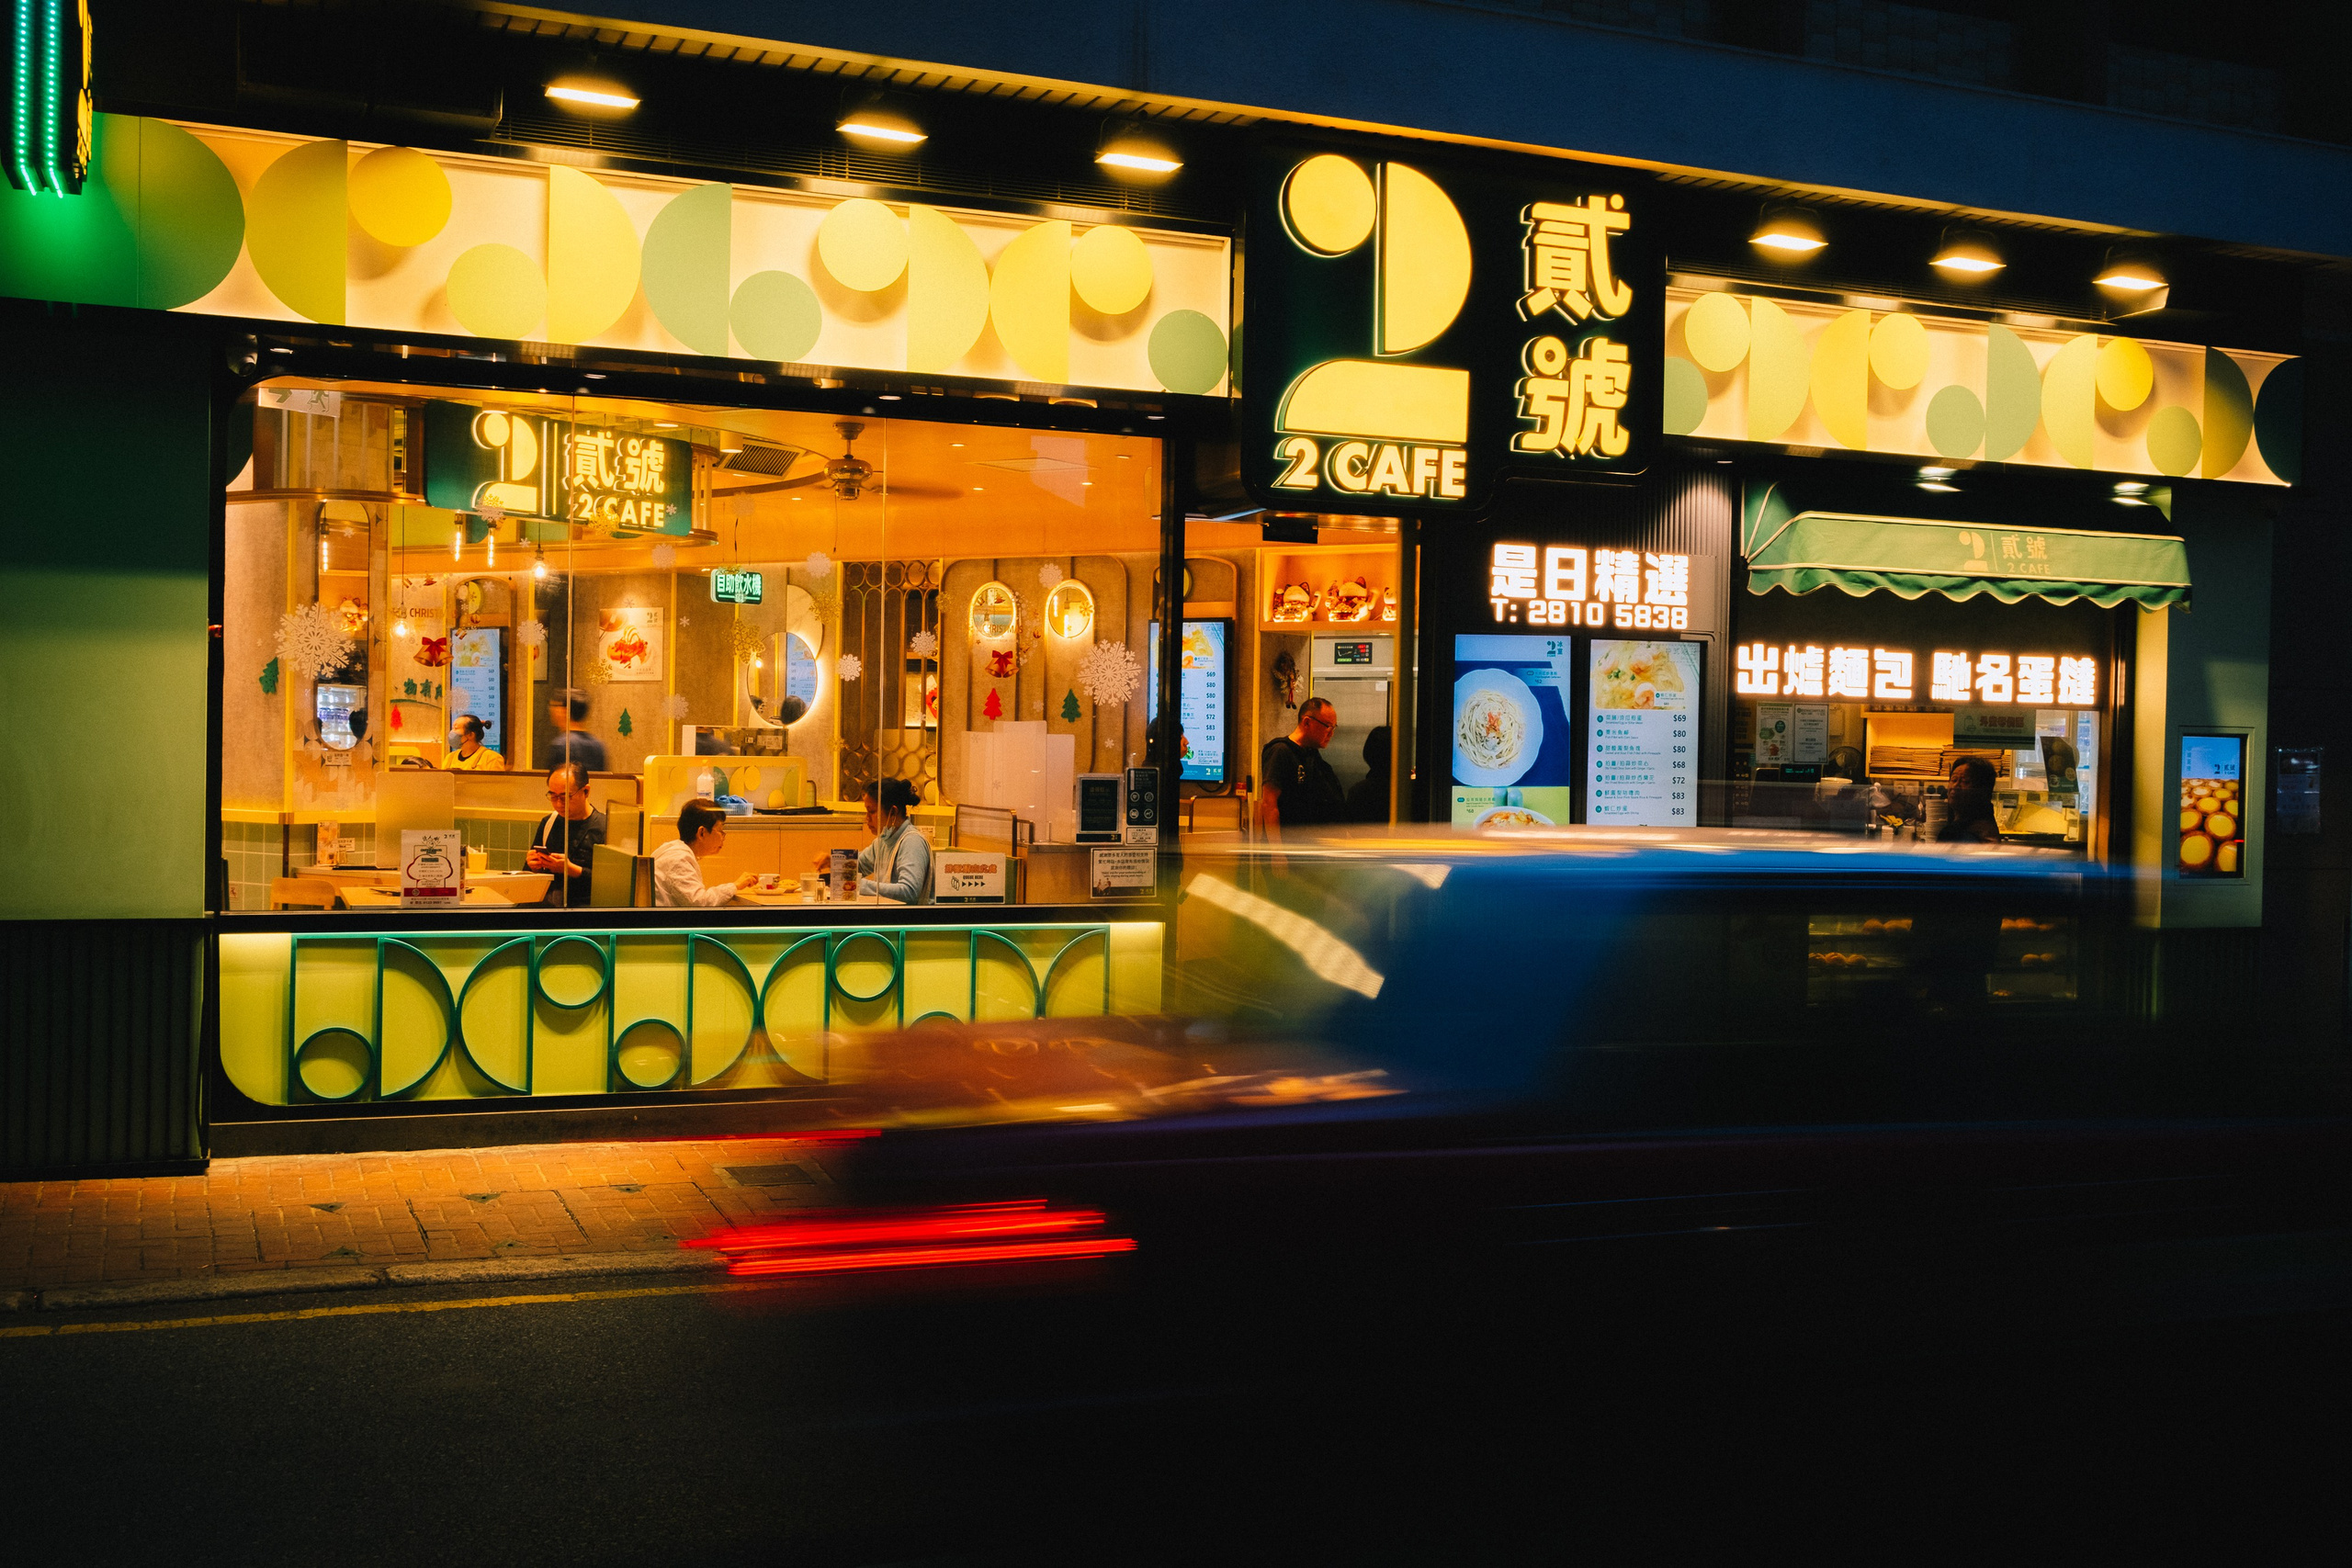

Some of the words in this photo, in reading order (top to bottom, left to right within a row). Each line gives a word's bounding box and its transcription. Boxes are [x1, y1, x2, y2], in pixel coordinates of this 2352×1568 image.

[1275, 152, 1472, 445] 2
[1513, 193, 1634, 458] 貳號
[564, 429, 665, 494] 貳號
[1272, 435, 1319, 489] 2
[1325, 440, 1467, 500] CAFE
[571, 492, 594, 519] 2
[599, 497, 665, 528] CAFE
[2000, 533, 2048, 560] 貳號
[1490, 543, 1690, 606] 是日精選
[2007, 561, 2016, 573] 2
[2019, 562, 2052, 575] CAFE
[716, 573, 763, 597] 自助飲水機
[1490, 598, 1518, 624] T:
[1528, 599, 1605, 626] 2810
[1614, 604, 1689, 630] 5838
[1736, 643, 1914, 700] 出爐麵包
[1931, 651, 2096, 705] 馳名蛋撻
[1673, 714, 1687, 722] $69
[1673, 729, 1687, 738] $80
[1672, 745, 1686, 753] $80
[1672, 761, 1686, 769] $68
[1672, 776, 1686, 784] $72
[1671, 792, 1685, 800] $83
[1671, 807, 1685, 816] $83
